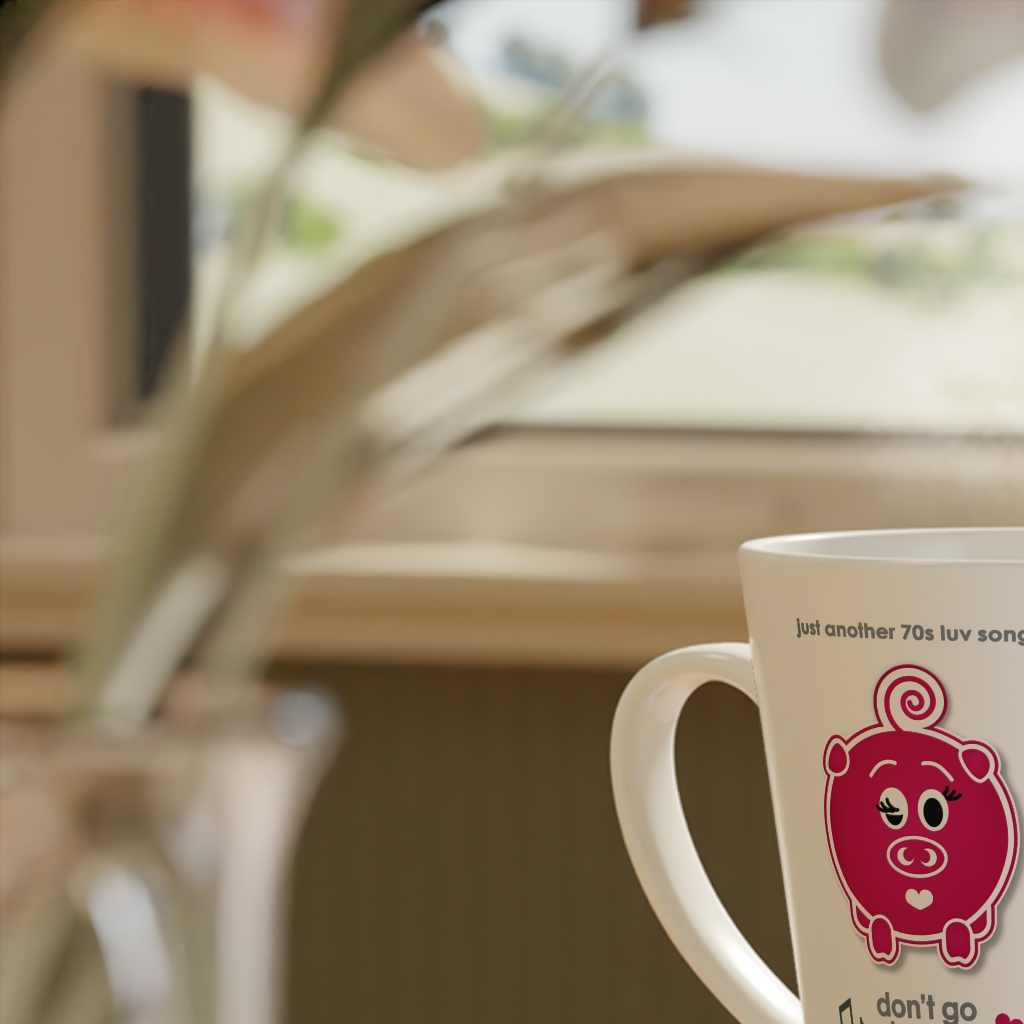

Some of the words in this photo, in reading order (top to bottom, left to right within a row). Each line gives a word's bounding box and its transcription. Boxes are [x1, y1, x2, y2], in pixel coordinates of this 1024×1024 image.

[796, 617, 820, 638] just
[824, 622, 895, 640] another
[901, 624, 935, 641] 70s
[940, 624, 972, 642] luv
[876, 991, 935, 1020] don't
